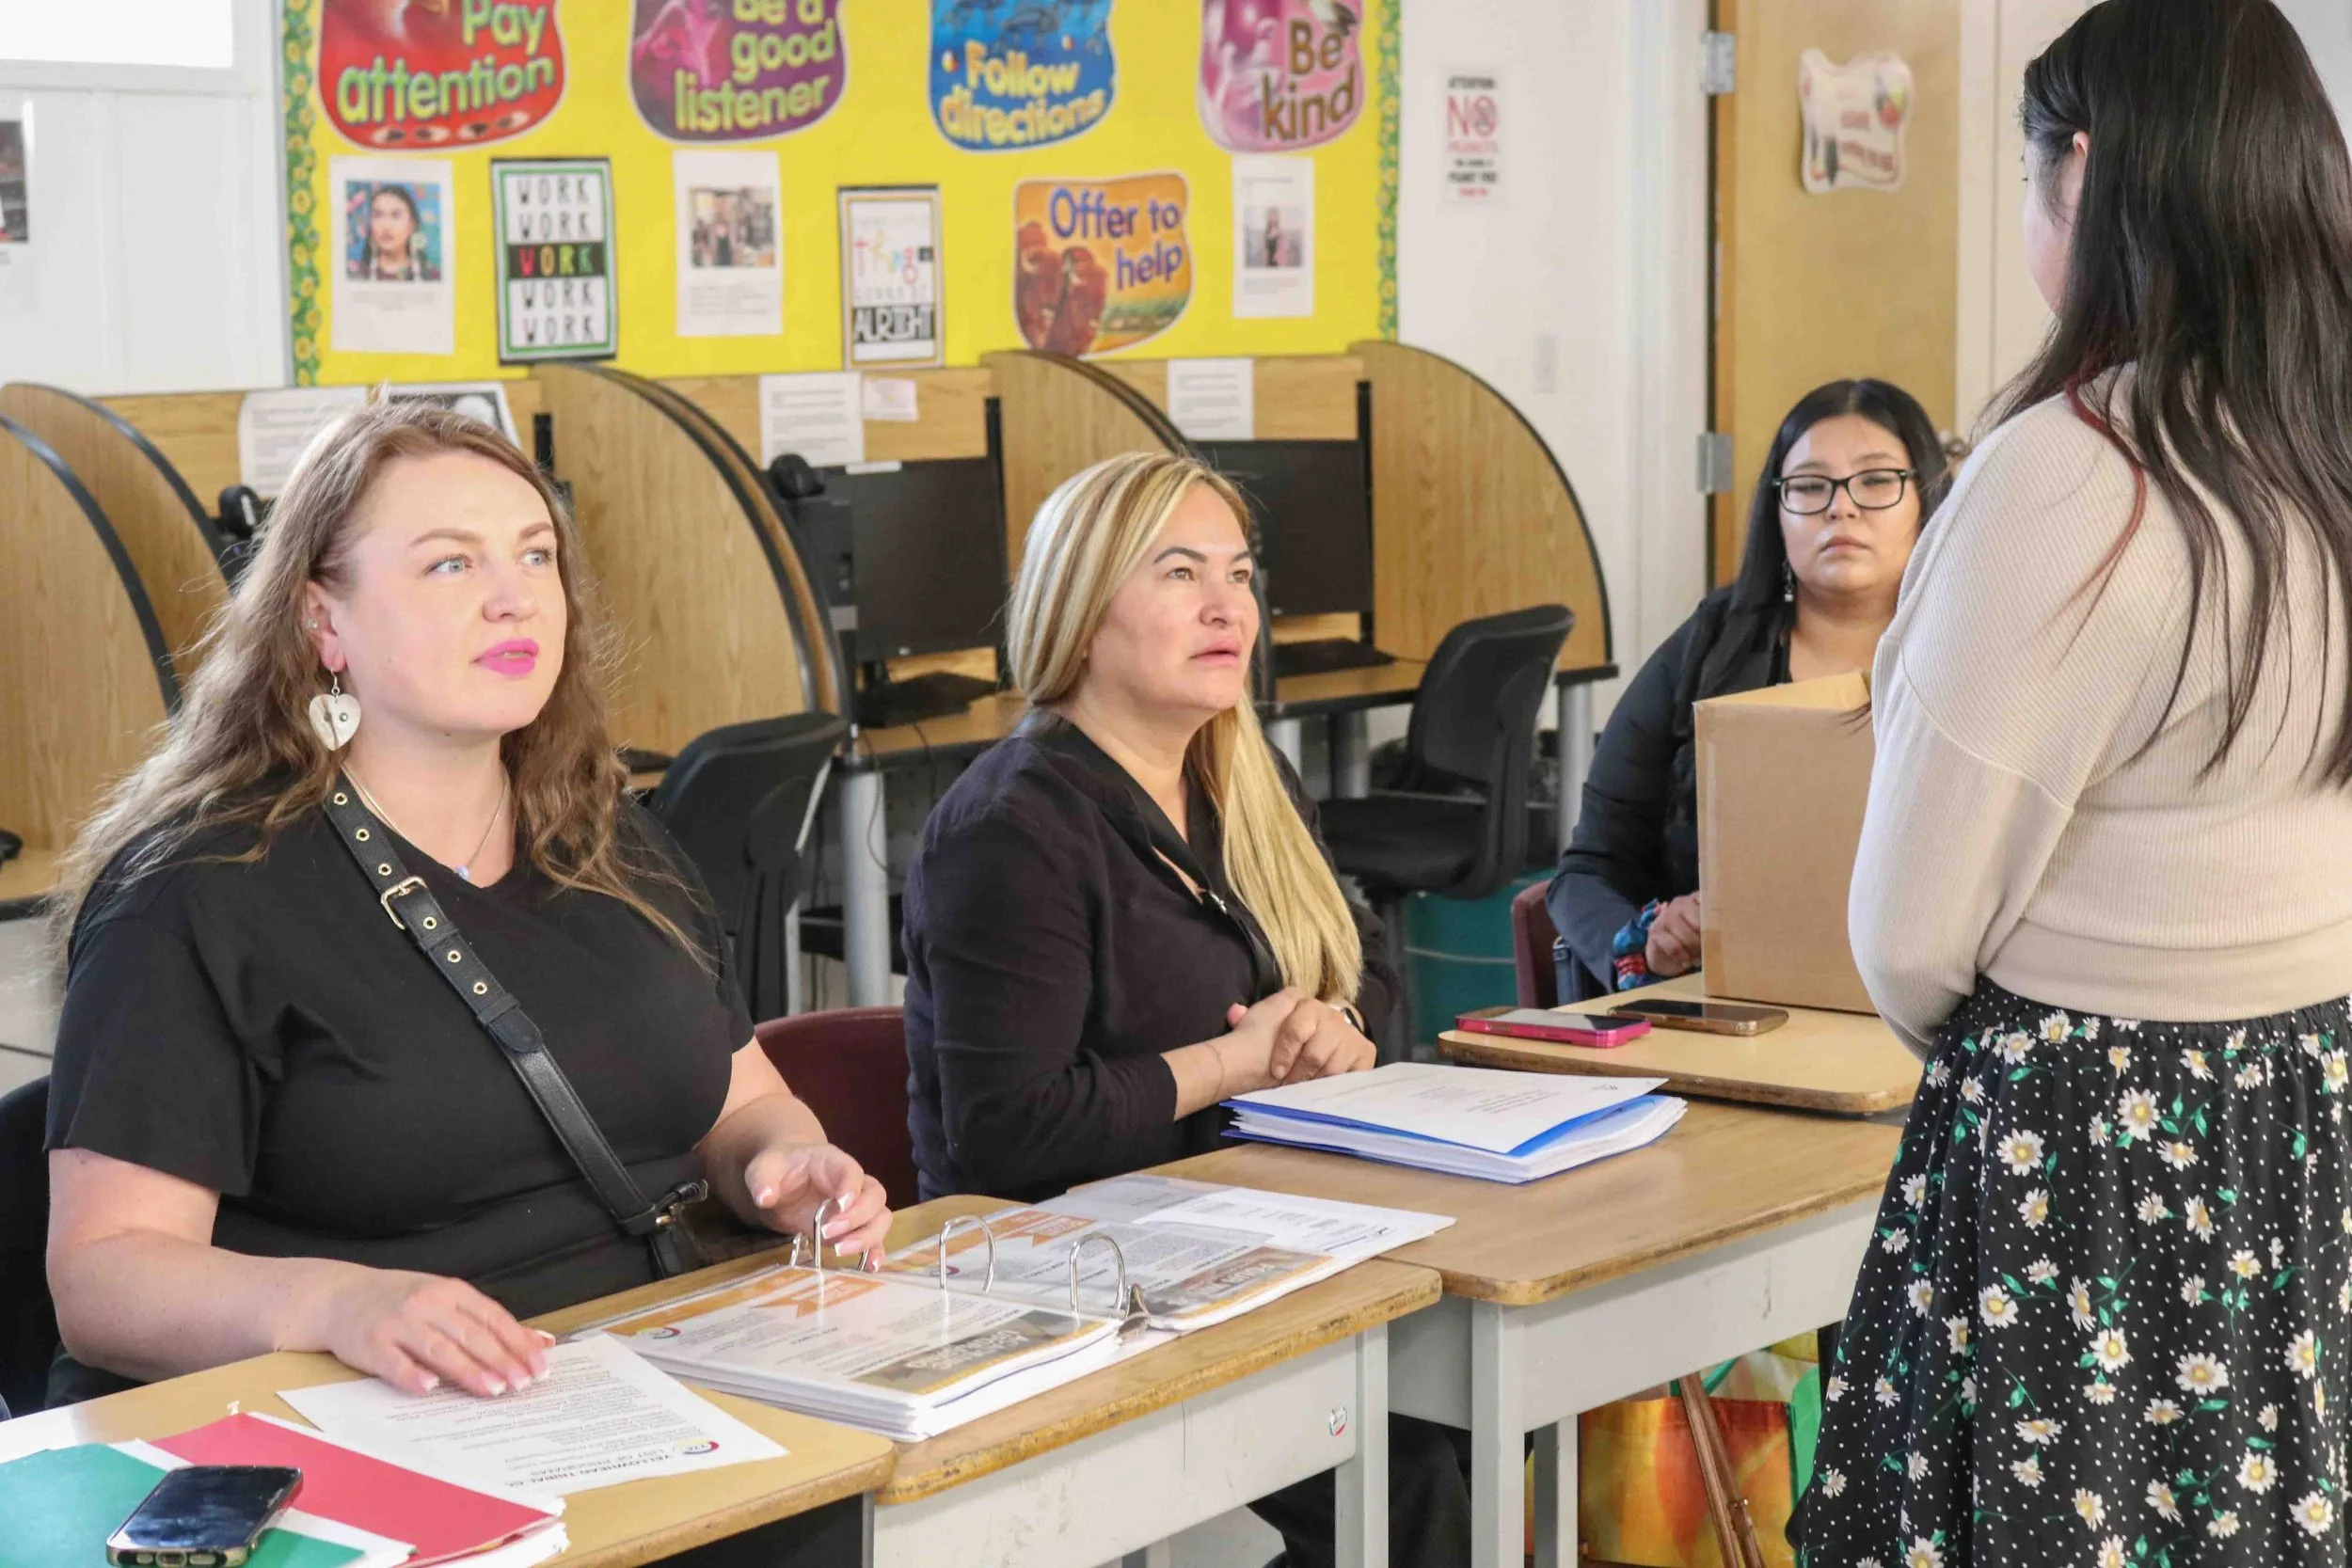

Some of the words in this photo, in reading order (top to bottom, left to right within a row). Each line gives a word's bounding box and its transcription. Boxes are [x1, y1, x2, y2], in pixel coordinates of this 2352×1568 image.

[462, 0, 547, 55] Pay
[731, 18, 835, 84] good
[1291, 19, 1343, 74] Be
[337, 54, 555, 124] attention
[965, 40, 1080, 97] Follow
[675, 68, 831, 131] listener
[940, 84, 1105, 146] directions
[1263, 62, 1356, 142] kind
[1447, 95, 1498, 136] NO
[516, 175, 590, 205] WORK
[1050, 187, 1138, 239] Offer
[1149, 198, 1180, 231] to
[518, 211, 592, 241] WORK
[519, 245, 593, 277] WORK
[1115, 240, 1184, 292] help
[522, 280, 595, 309] WORK
[523, 314, 596, 345] WORK
